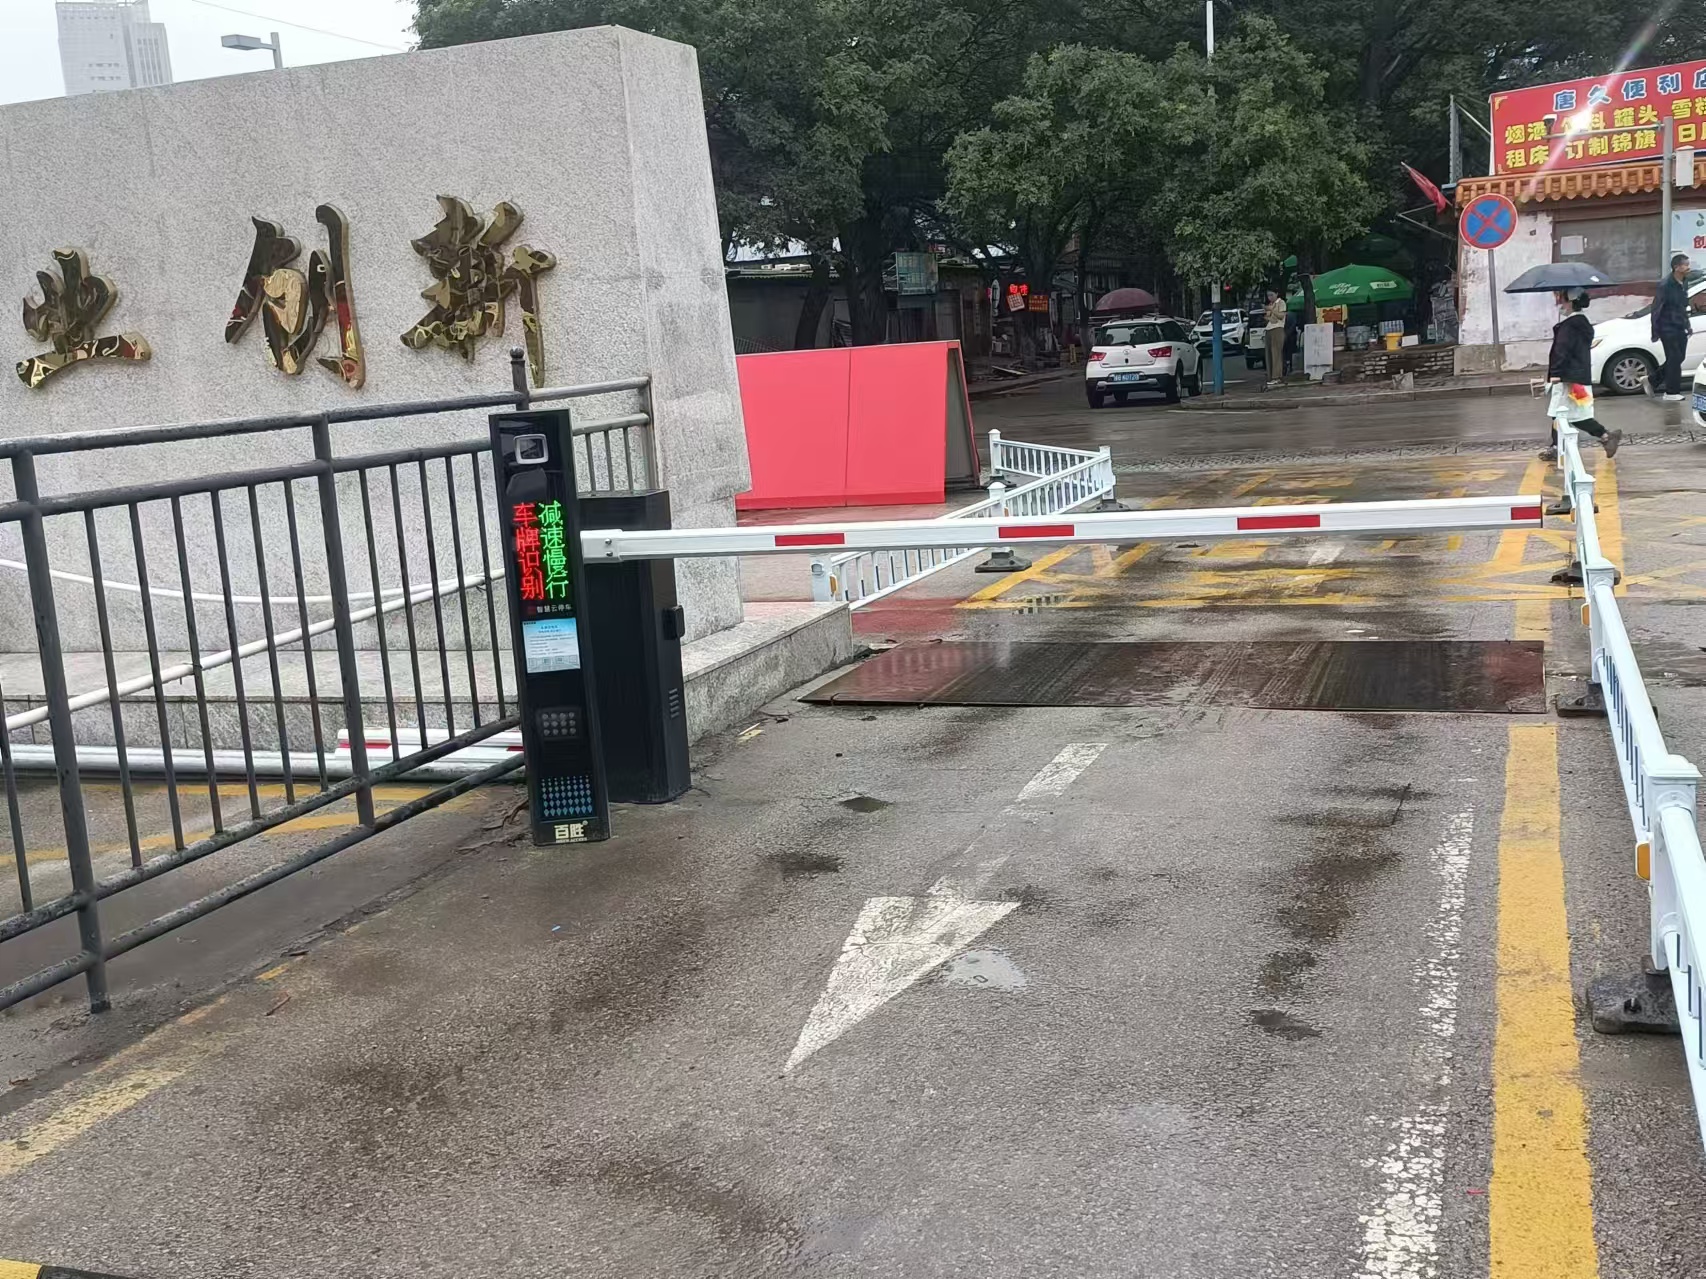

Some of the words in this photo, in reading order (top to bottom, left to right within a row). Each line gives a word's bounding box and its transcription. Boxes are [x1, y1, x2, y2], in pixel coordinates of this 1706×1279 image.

[1505, 121, 1547, 144] 烟酒
[1614, 104, 1658, 127] 罐头
[1565, 131, 1656, 159] 订制锦旗
[513, 502, 545, 600] 车牌识别
[538, 500, 569, 599] 减速慢行
